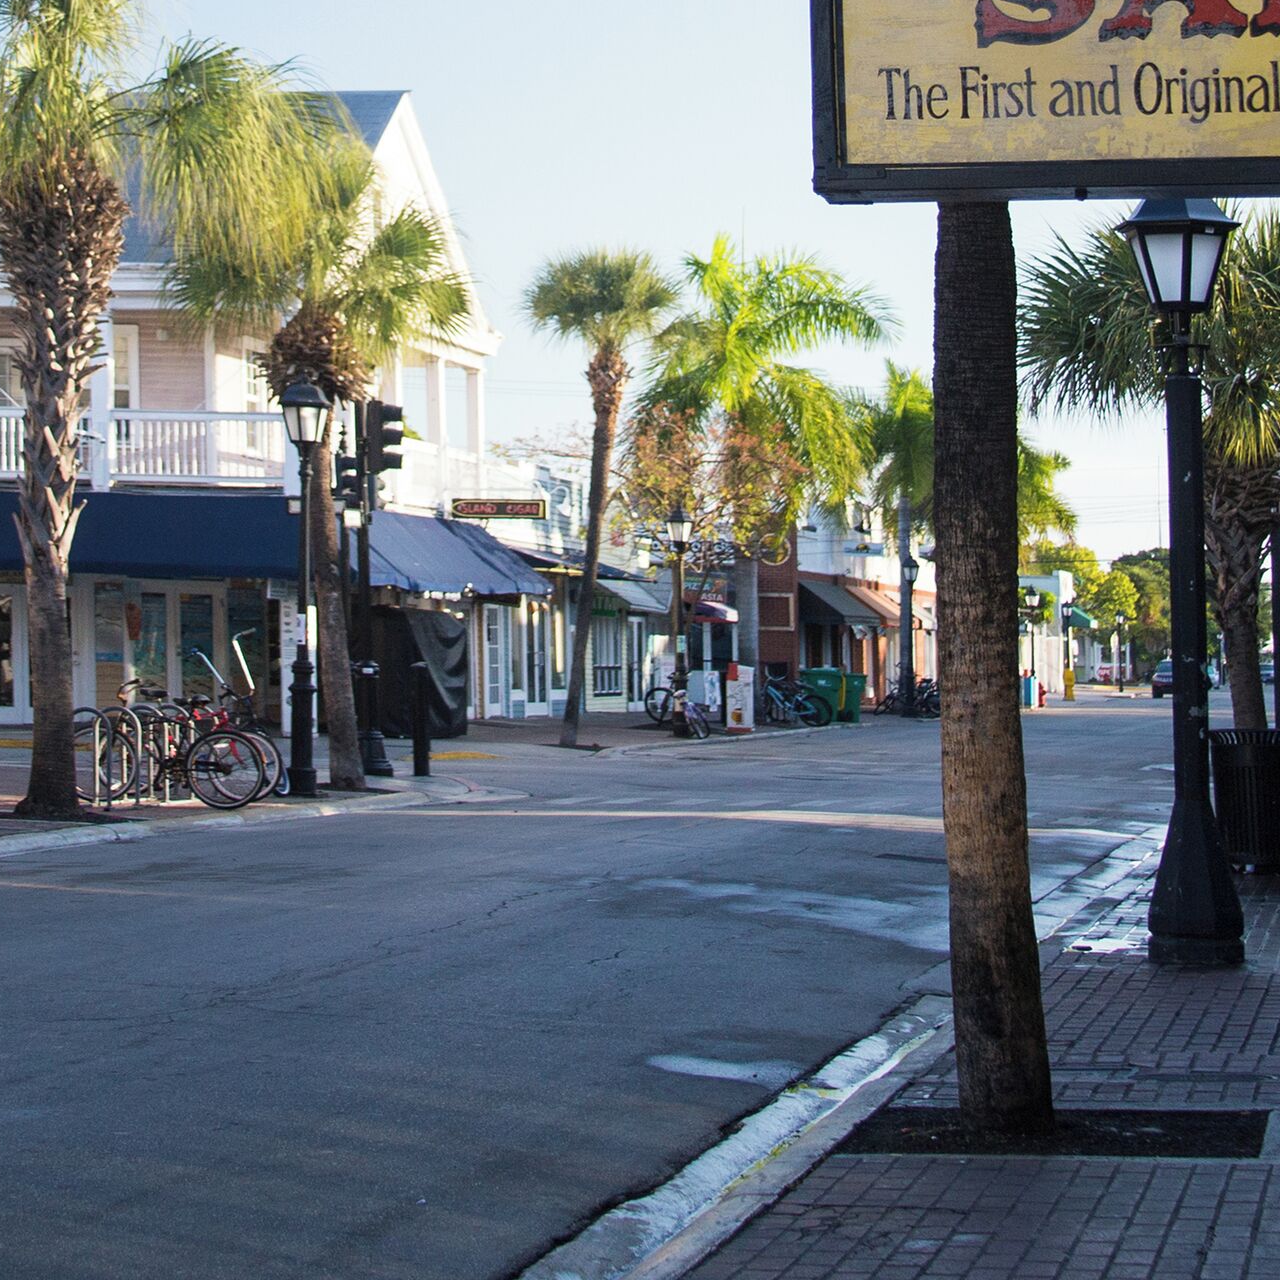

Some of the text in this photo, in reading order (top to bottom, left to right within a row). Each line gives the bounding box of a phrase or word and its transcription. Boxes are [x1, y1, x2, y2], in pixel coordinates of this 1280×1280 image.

[877, 65, 949, 120] The
[959, 65, 1037, 119] First
[1049, 64, 1120, 116] and
[505, 504, 539, 514] CIGAR
